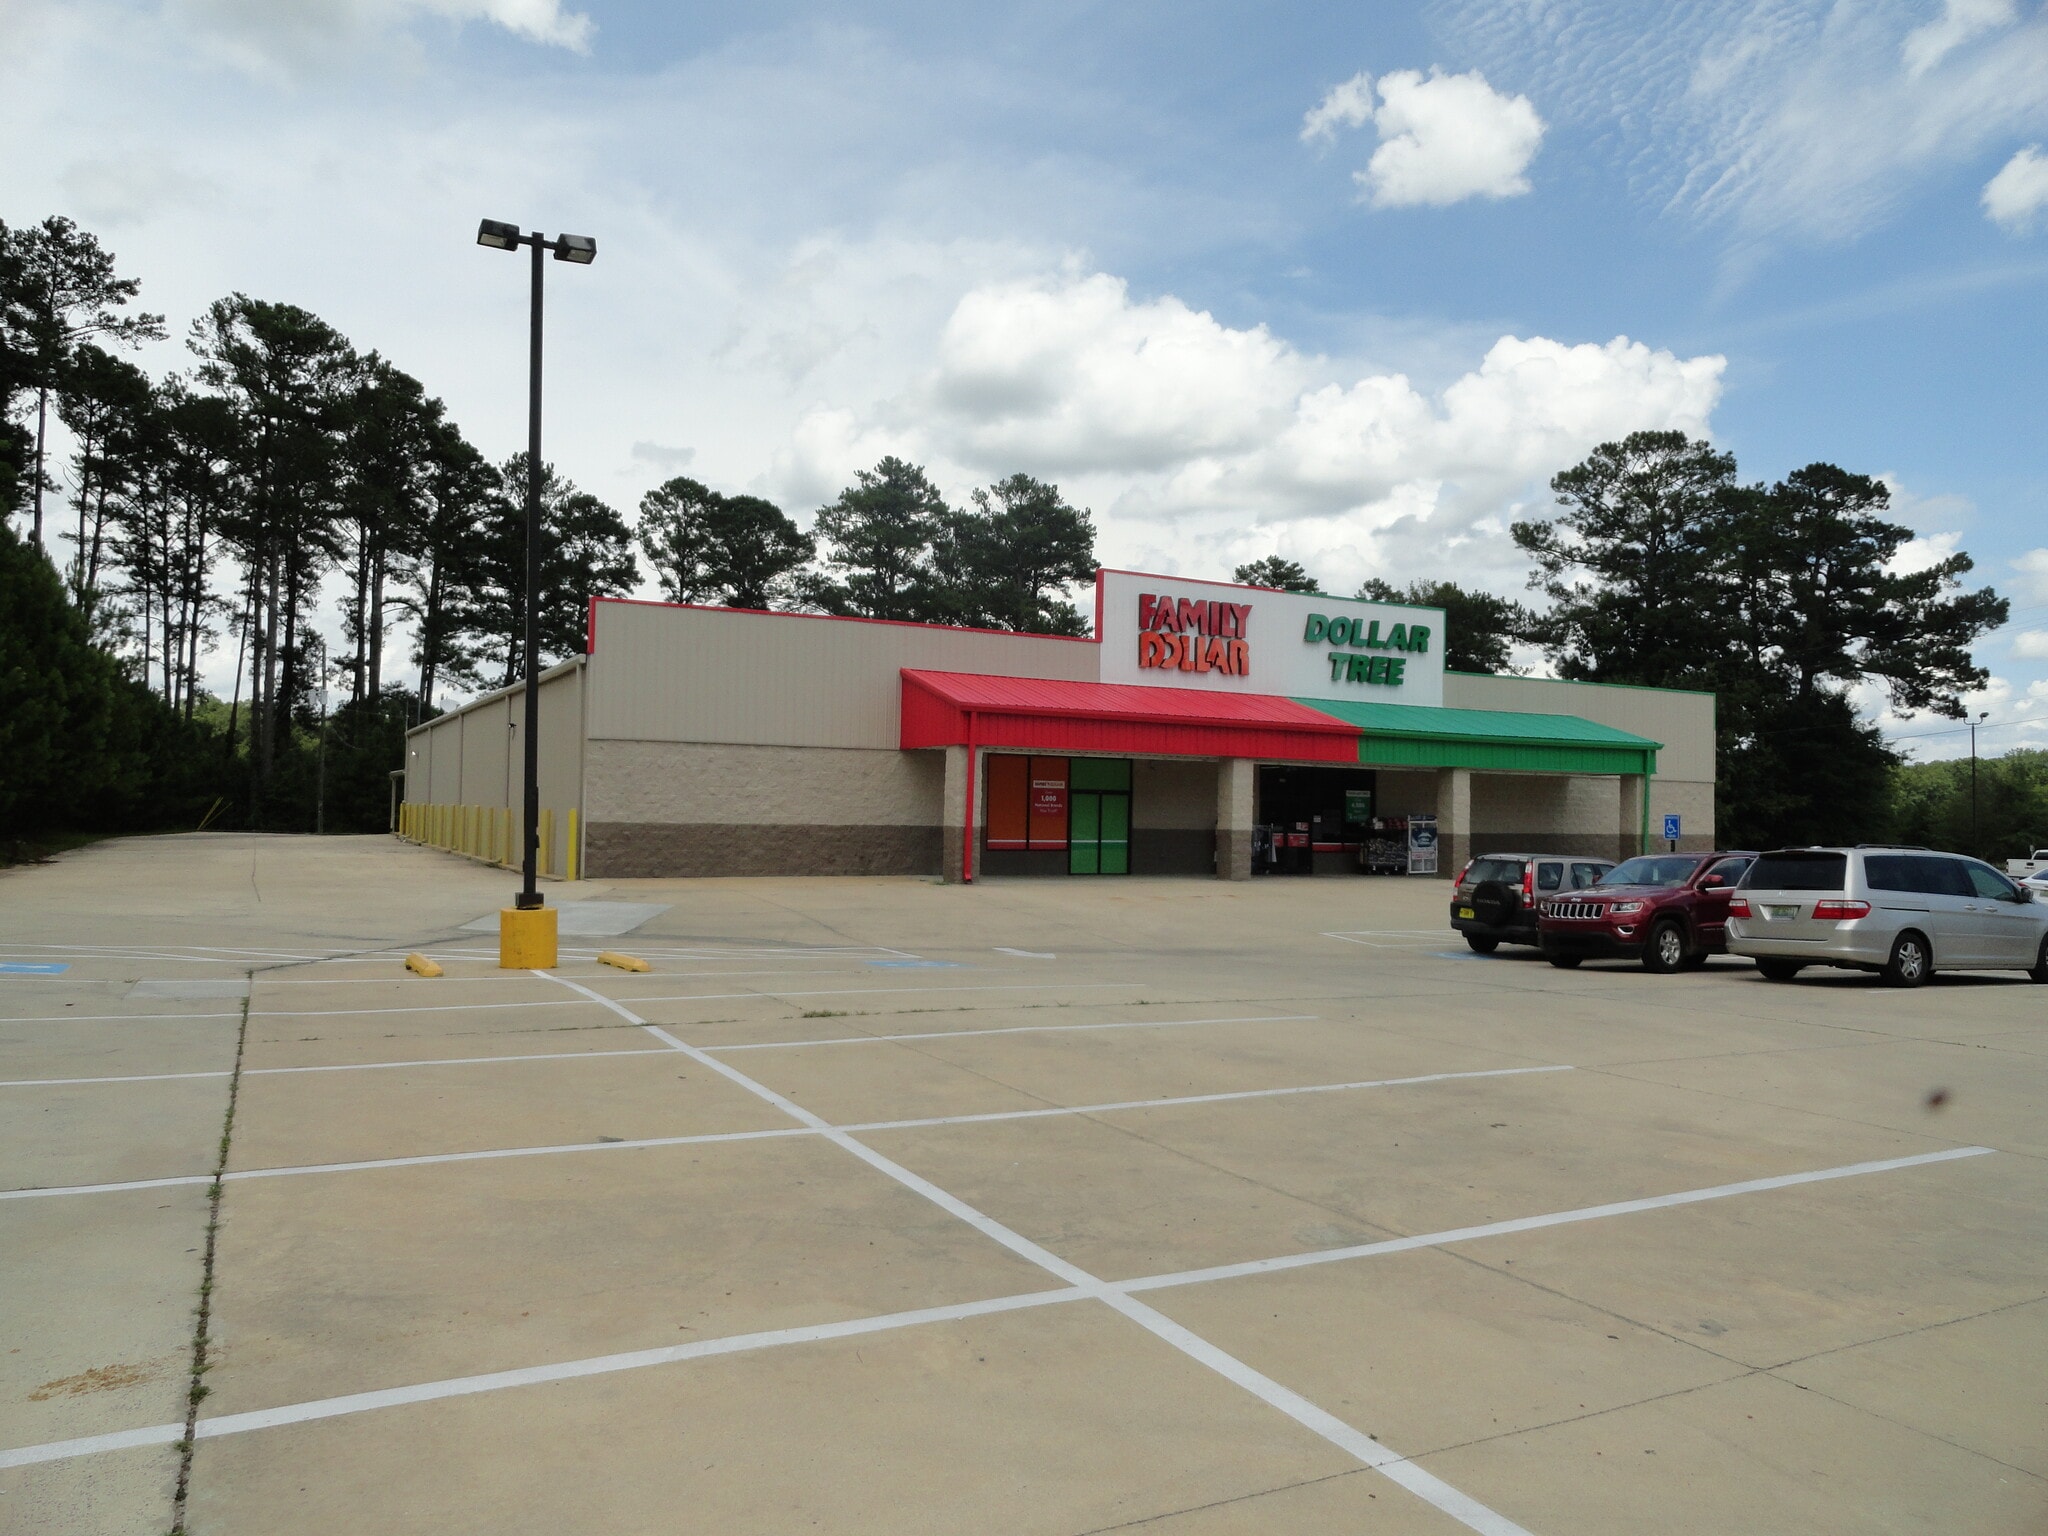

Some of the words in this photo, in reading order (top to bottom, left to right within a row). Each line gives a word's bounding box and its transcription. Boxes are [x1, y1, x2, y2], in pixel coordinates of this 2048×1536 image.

[1138, 593, 1253, 638] FAMILY
[1304, 613, 1431, 653] DOLLAR
[1138, 630, 1250, 676] DOLLAR
[1328, 651, 1407, 685] TREE
